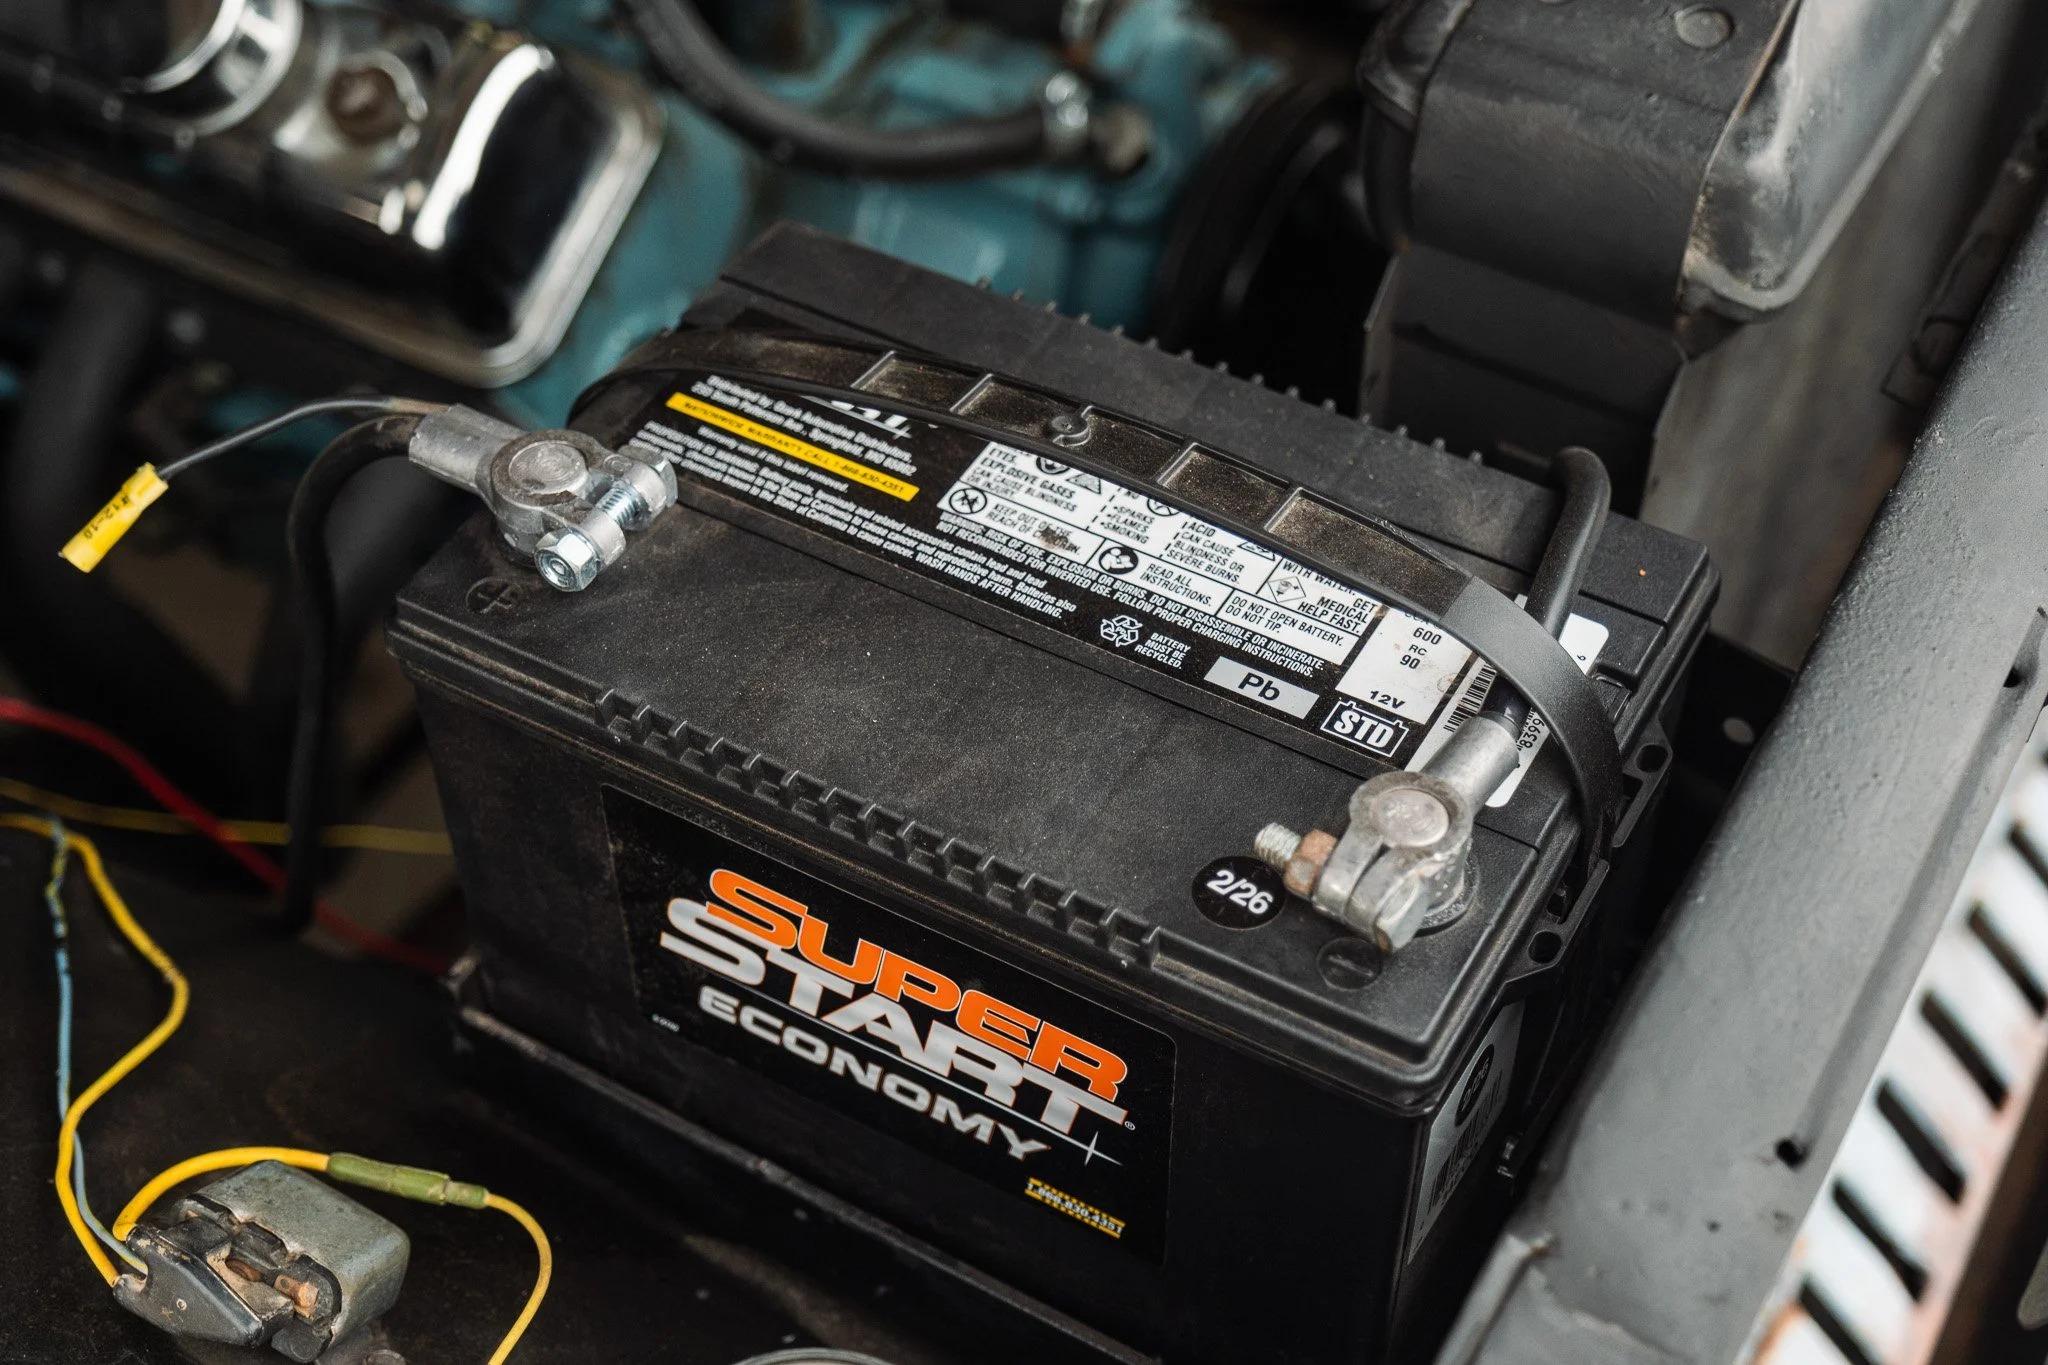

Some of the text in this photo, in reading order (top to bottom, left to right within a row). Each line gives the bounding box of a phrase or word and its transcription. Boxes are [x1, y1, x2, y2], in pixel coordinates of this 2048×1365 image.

[973, 469, 1076, 511] CAN CAUSE BLINDNESS
[980, 457, 1075, 499] EXPLOSIVE GASES
[1181, 531, 1234, 556] CAN CAUSE
[1188, 521, 1215, 537] ACID
[902, 526, 954, 551] accessories
[953, 545, 986, 564] contain
[985, 557, 1008, 572] lead
[1005, 567, 1026, 580] and
[1023, 573, 1047, 588] lead
[1166, 549, 1239, 582] SEVERE BURNS.
[1173, 540, 1244, 572] BLINDNESS OR
[1282, 560, 1312, 578] WITH
[915, 552, 946, 570] WASH
[944, 564, 980, 584] HANDS
[977, 578, 1011, 597] AFTER
[1010, 591, 1062, 618] HANDLING.
[934, 550, 988, 576] reproductive
[987, 570, 1013, 587] harm.
[1015, 581, 1056, 603] Batteries
[1055, 599, 1076, 612] also
[1140, 572, 1211, 605] INSTRUCTIONS.
[1146, 563, 1191, 586] READ ALL
[935, 520, 1312, 677] NOT RECOMMENDED FOR INVERTED USE. FOLLOW PROPER CHARGING INSTRUCTIONS.
[985, 529, 1009, 544] RISK
[1007, 538, 1023, 549] OF
[1046, 554, 1099, 580] EXPLOSION
[1097, 574, 1114, 586] OR
[1112, 579, 1147, 599] BURNS.
[1148, 593, 1165, 606] DO
[1164, 600, 1187, 614] NOT
[1186, 609, 1252, 640] DISASSEMBLE
[1251, 634, 1267, 646] OR
[1266, 640, 1324, 670] INCINERATE.
[1316, 596, 1367, 623] MEDICAL
[1352, 597, 1376, 612] GET
[1225, 604, 1281, 633] DO NOT TIP.
[1231, 595, 1343, 646] DO NOT OPEN BATTERY.
[1297, 601, 1360, 633] HELP FAST.
[1144, 639, 1185, 660] MUST BE
[1150, 632, 1190, 652] BATTERY
[1408, 644, 1427, 656] RC
[1413, 627, 1441, 644] 600
[1134, 644, 1181, 669] RECYCLED.
[1399, 654, 1420, 669] 90
[1238, 672, 1279, 700] Pb
[1370, 690, 1405, 709] 12V
[1334, 710, 1393, 747] STD
[1519, 718, 1545, 749] 8399
[1206, 869, 1273, 914] 2/26
[706, 868, 1128, 1103] SUPER
[660, 898, 1129, 1136] START
[699, 985, 1051, 1160] ECONOMY
